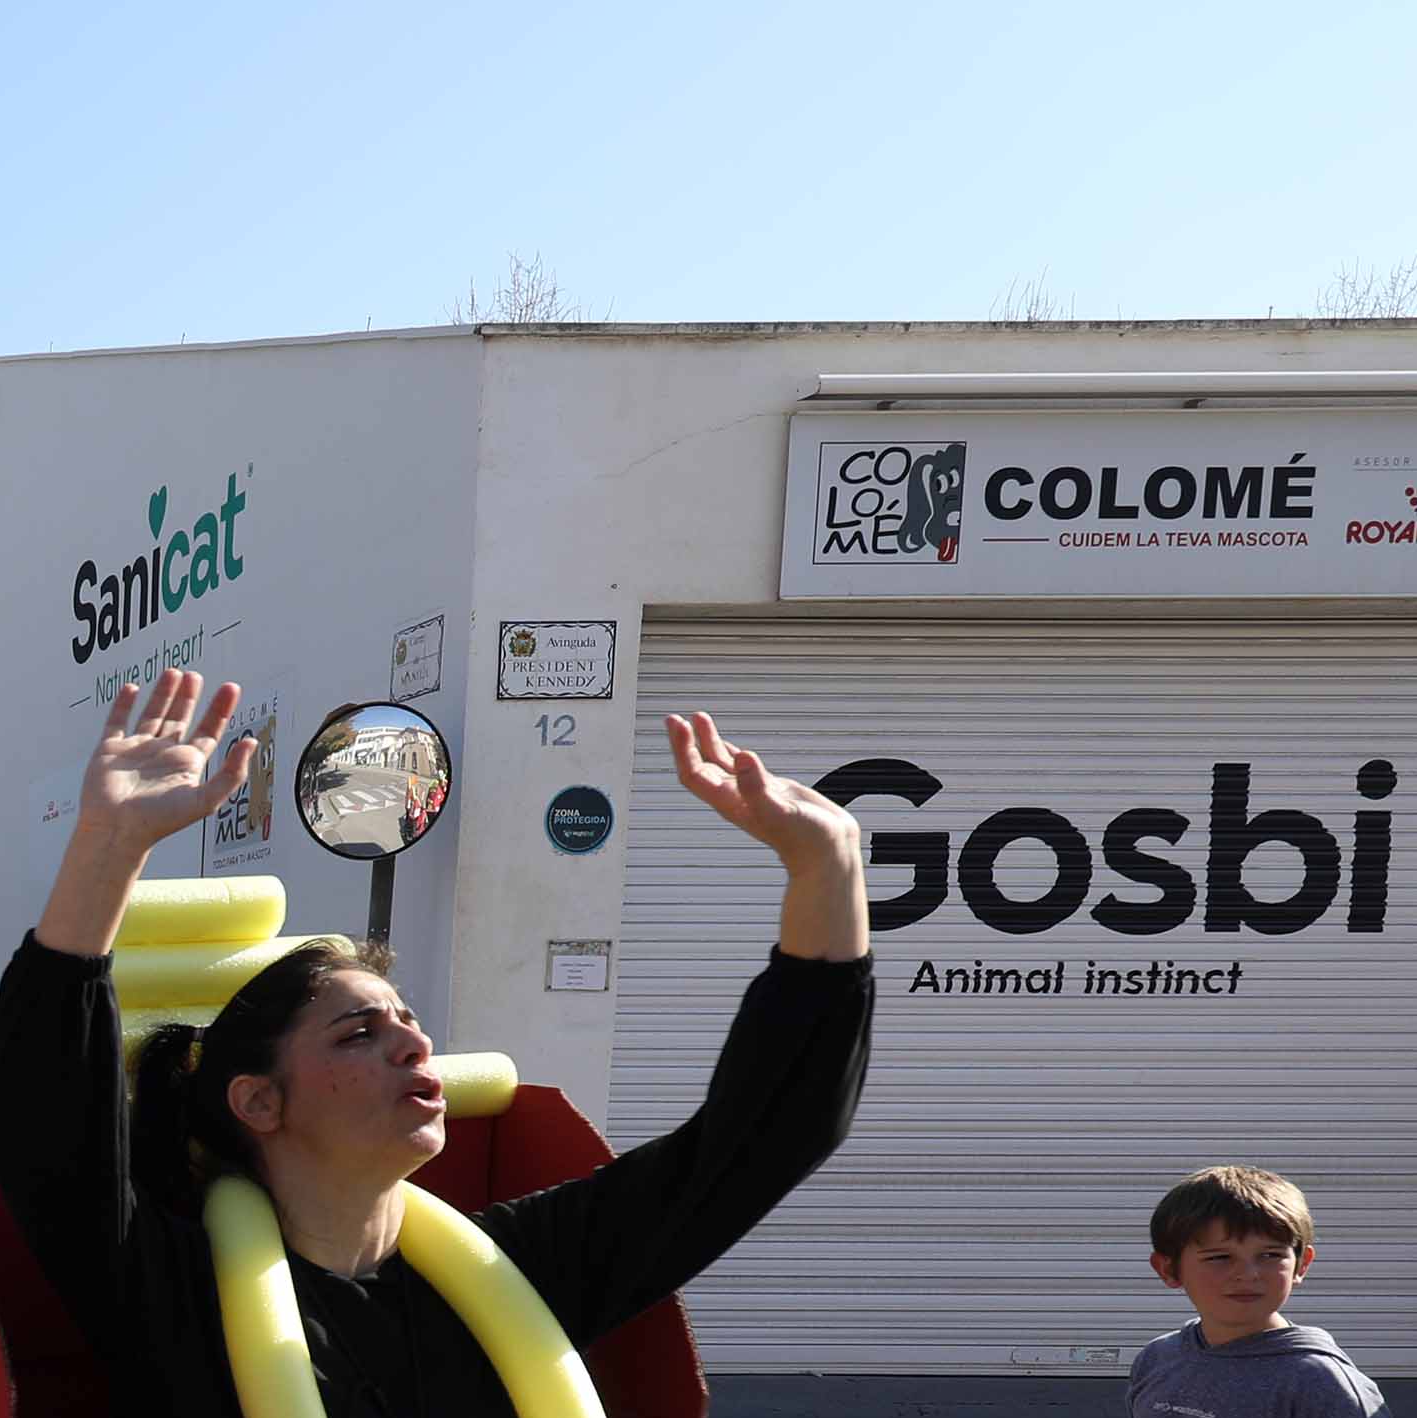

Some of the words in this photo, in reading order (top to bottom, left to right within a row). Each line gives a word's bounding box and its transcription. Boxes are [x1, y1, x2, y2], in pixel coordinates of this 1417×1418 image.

[984, 453, 1316, 520] COLOMÉ
[1059, 532, 1131, 548] CUIDEM
[1136, 532, 1160, 548] LA
[1164, 532, 1212, 548] TEVA
[1216, 532, 1309, 549] MASCOTA
[1346, 520, 1417, 544] ROYA
[72, 472, 246, 664] Sanicat
[547, 636, 597, 650] Avinguda
[95, 664, 140, 707] Nature
[145, 648, 159, 683] at
[163, 624, 204, 672] heart
[512, 661, 596, 673] PRESIDENT
[525, 675, 597, 688] KENNEDY
[534, 714, 576, 746] 12
[554, 809, 581, 817] ZONA
[554, 816, 606, 825] PROTEGIDA
[812, 757, 1398, 936] Gosbi
[909, 960, 1064, 994] Animal
[1084, 960, 1244, 995] instinct
